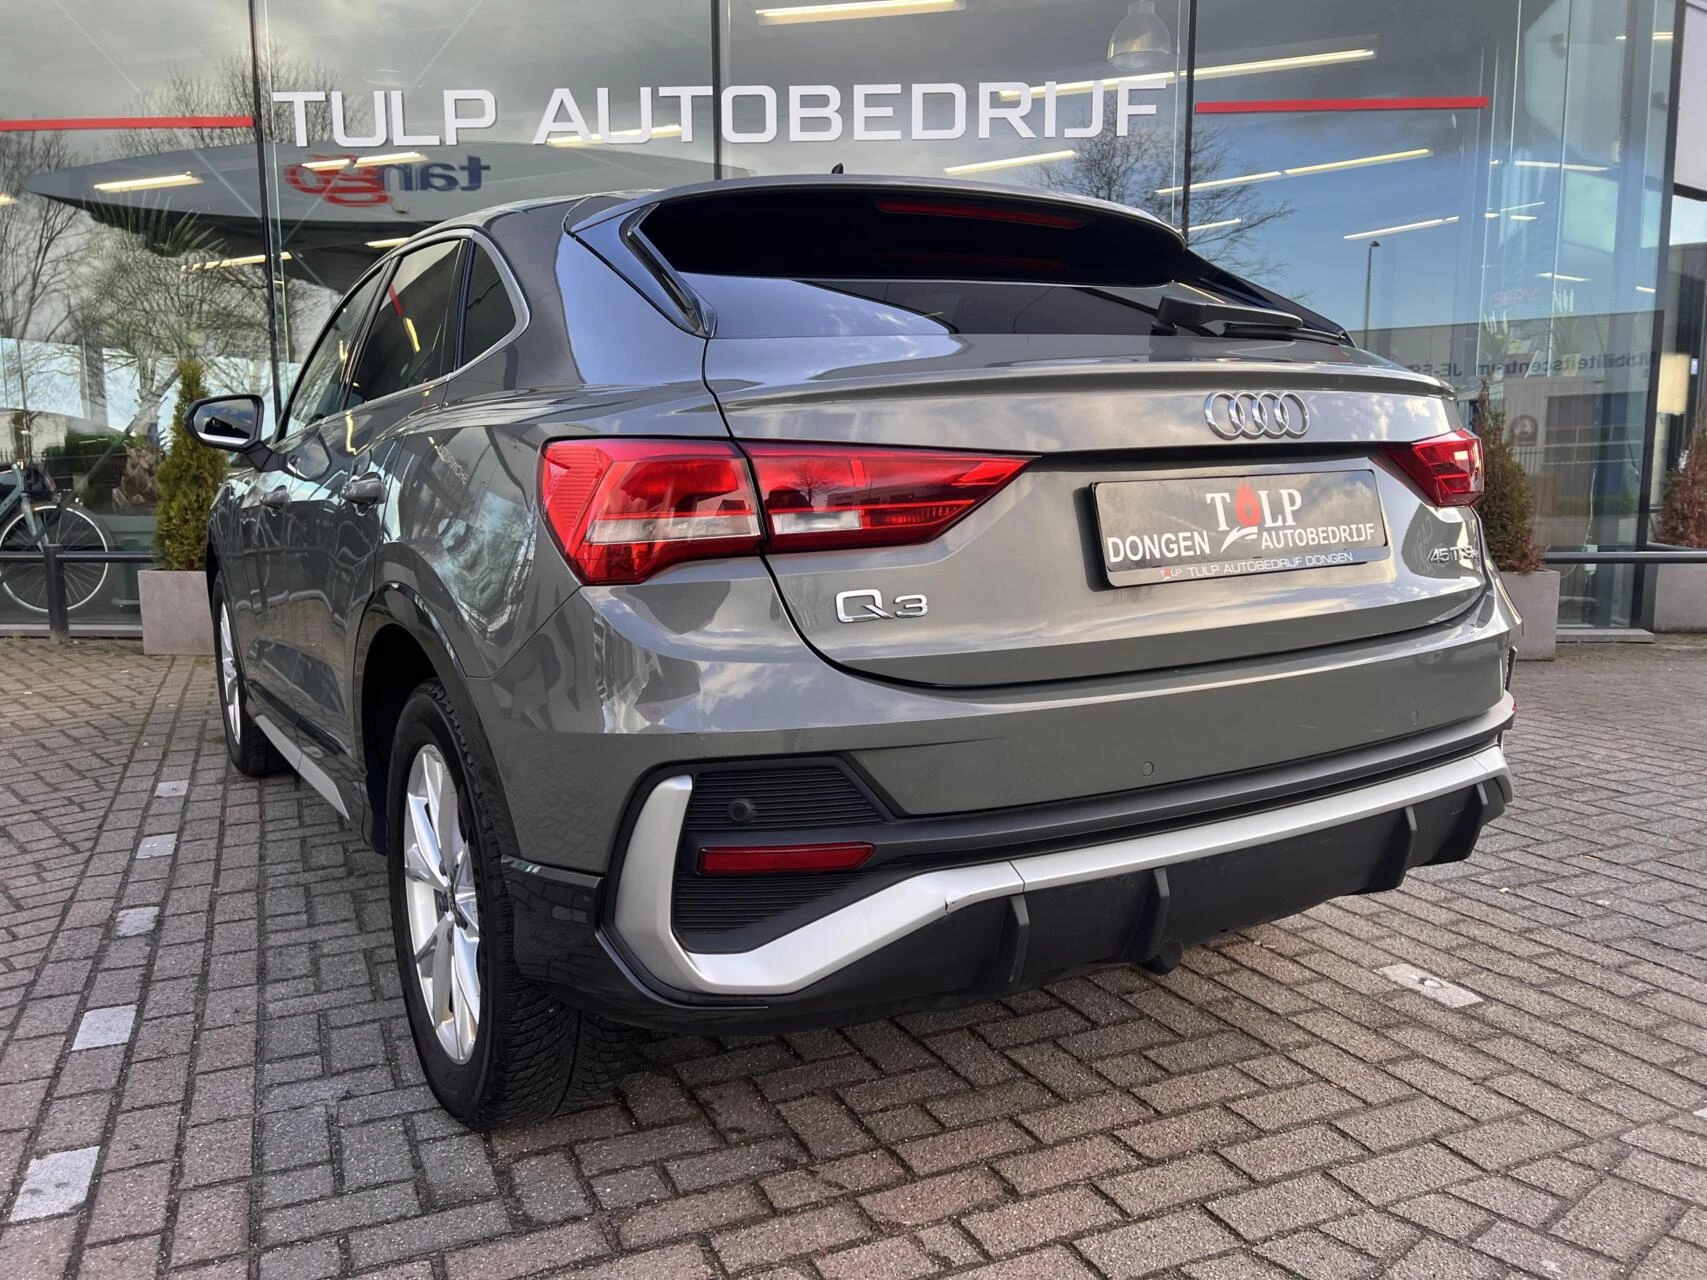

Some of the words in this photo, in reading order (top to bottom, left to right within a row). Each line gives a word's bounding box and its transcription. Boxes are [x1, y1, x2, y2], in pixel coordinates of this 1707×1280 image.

[272, 90, 497, 147] TULP
[532, 80, 1167, 144] AUTOBEDRIJF
[1107, 530, 1211, 563] DONGEN
[1261, 523, 1375, 550] AUTOBEDRIJF
[1187, 564, 1220, 578] TULP
[1223, 556, 1303, 574] AUTOBEDRIJF
[1305, 552, 1353, 565] DONGEN
[1428, 547, 1449, 563] 45
